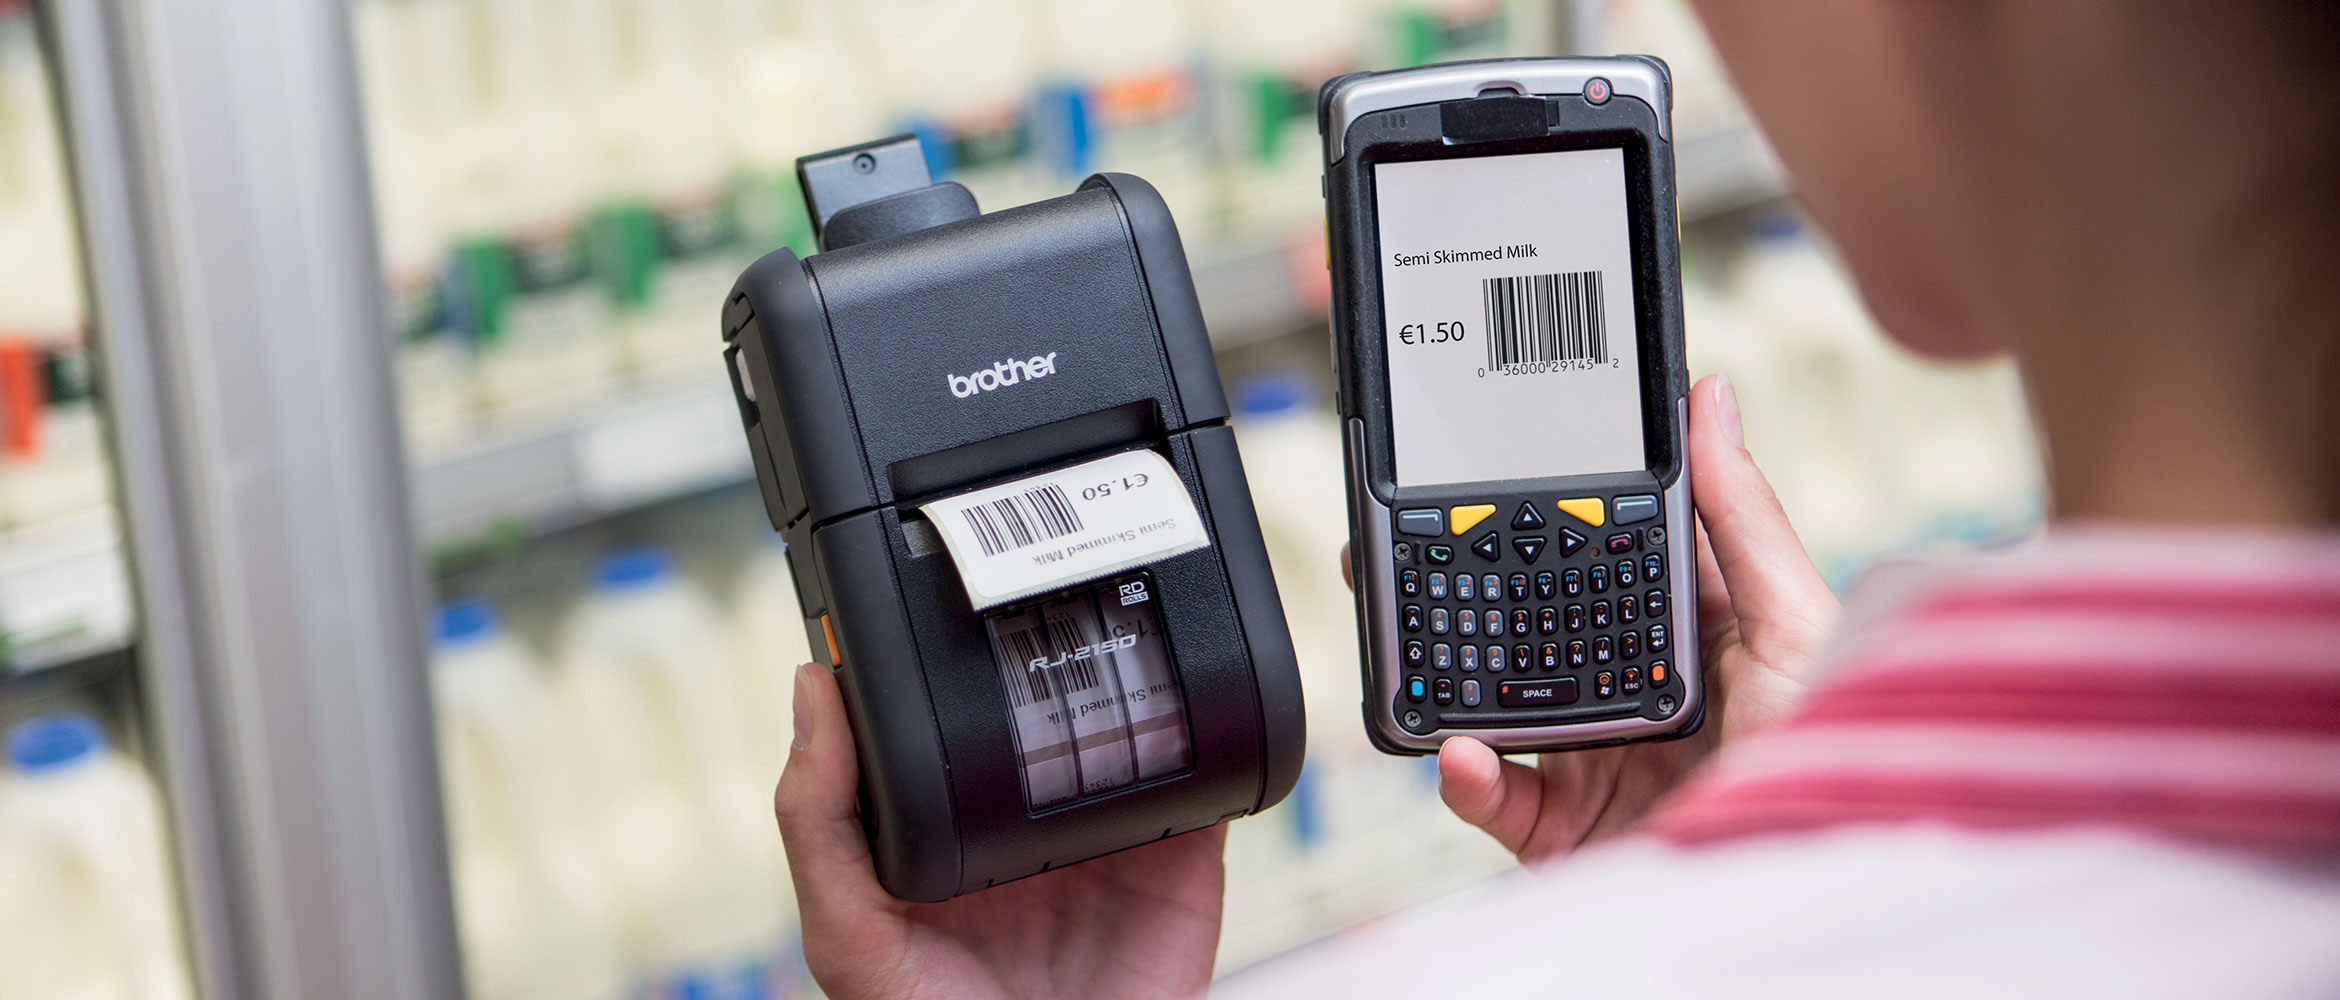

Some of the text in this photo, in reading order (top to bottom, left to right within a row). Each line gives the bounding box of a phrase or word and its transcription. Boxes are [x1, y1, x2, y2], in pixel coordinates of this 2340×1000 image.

[1394, 244, 1538, 267] Semi Skimmed Milk
[1399, 320, 1465, 345] €1.50
[947, 351, 1057, 398] brother
[1478, 358, 1619, 378] 0 36000 29145 2
[1082, 473, 1149, 501] €1.50
[1032, 518, 1176, 566] Semi Skimmed Milk
[1119, 581, 1145, 597] RD
[1405, 582, 1416, 593] Q
[1431, 586, 1444, 595] W
[1461, 587, 1469, 597] E
[1488, 587, 1497, 597] R
[1515, 587, 1524, 596] T
[1541, 585, 1550, 594] Y
[1569, 584, 1577, 593] U
[1650, 567, 1658, 577] P
[1122, 593, 1148, 606] ROLLS
[1409, 609, 1633, 633] A S D F G H J K L
[1029, 634, 1137, 672] RJ-2150
[1438, 656, 1447, 665] Z
[1465, 657, 1473, 667] X
[1491, 658, 1500, 667] C
[1518, 658, 1528, 667] V
[1546, 656, 1554, 666] B
[1573, 654, 1582, 664] N
[1599, 650, 1608, 660] M
[1522, 689, 1553, 698] SPACE
